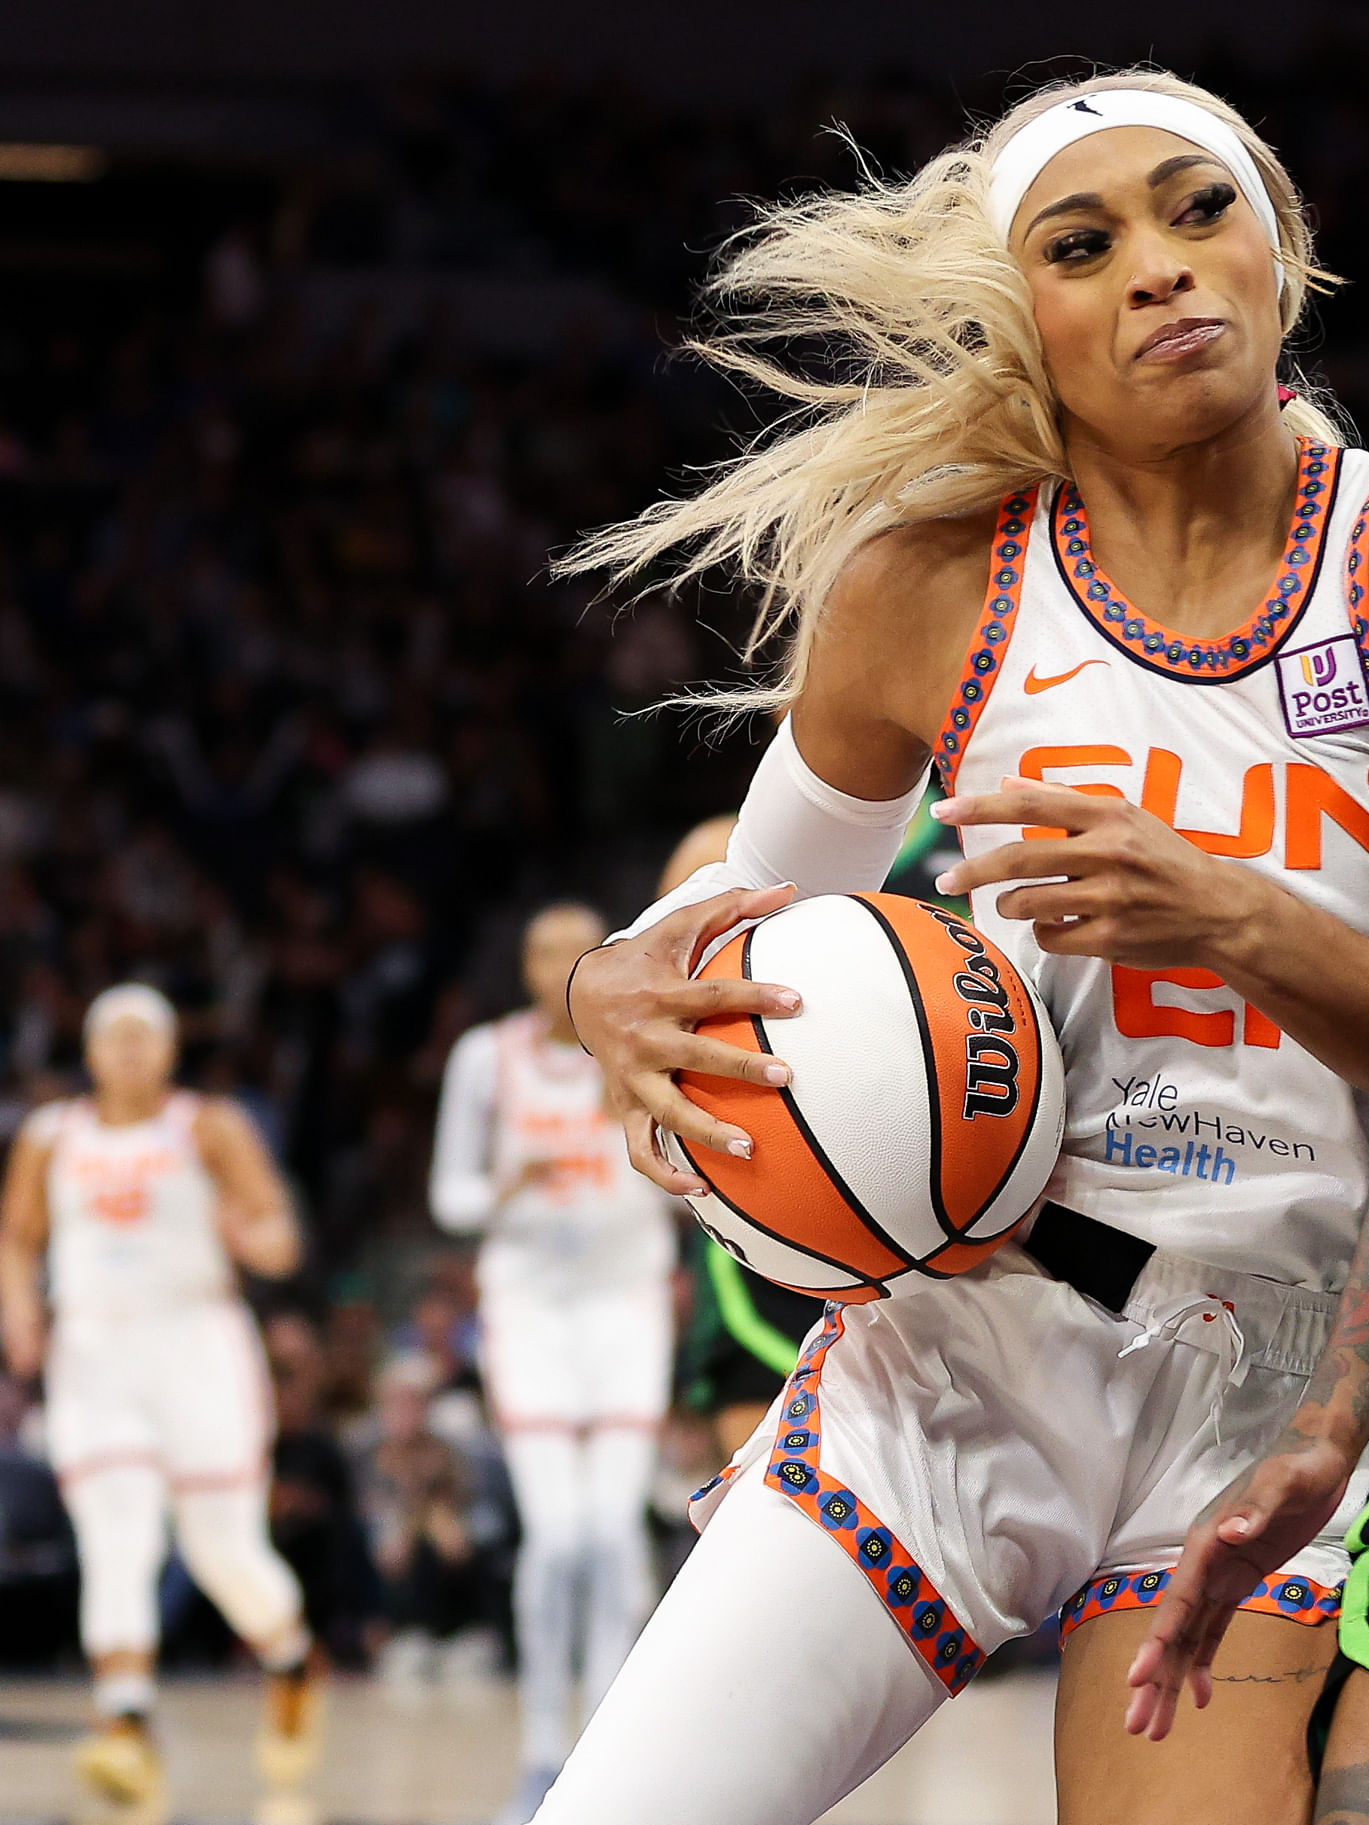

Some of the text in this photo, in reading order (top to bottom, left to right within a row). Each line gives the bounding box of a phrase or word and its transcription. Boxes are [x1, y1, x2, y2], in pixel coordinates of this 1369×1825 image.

[1291, 681, 1363, 717] Post
[1296, 708, 1362, 728] UNIVERSITY
[916, 903, 1021, 1120] Wilson
[1111, 1074, 1179, 1112] Yale
[1104, 1129, 1236, 1186] Health
